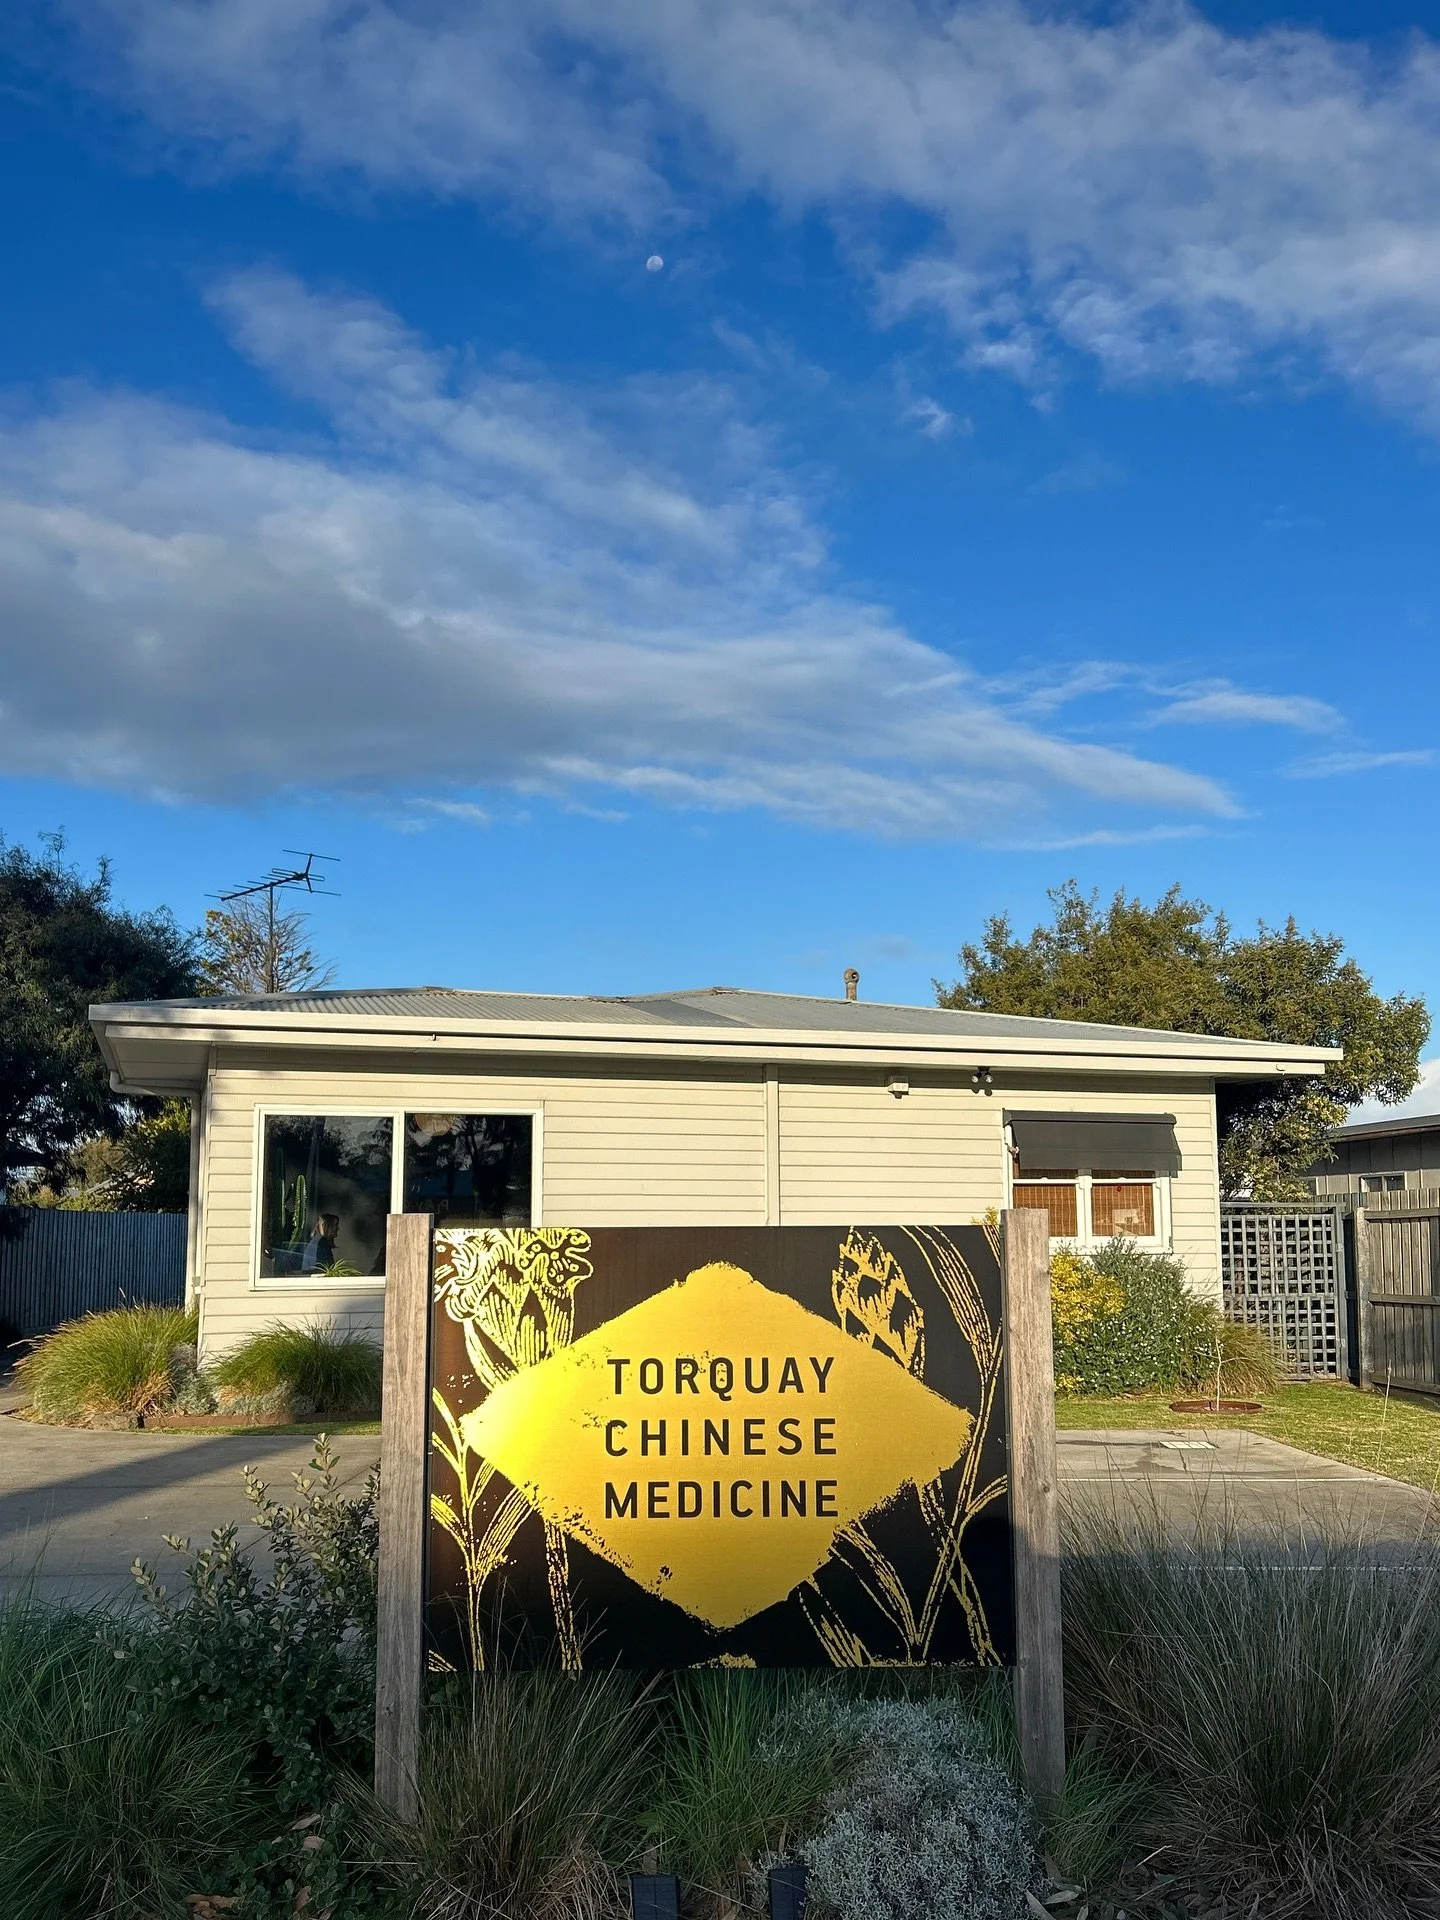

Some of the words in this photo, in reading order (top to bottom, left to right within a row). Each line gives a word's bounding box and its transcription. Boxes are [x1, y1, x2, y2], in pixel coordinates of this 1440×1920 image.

[606, 1357, 834, 1401] TORQUAY
[605, 1418, 837, 1456] CHINESE
[605, 1480, 838, 1518] MEDICINE
